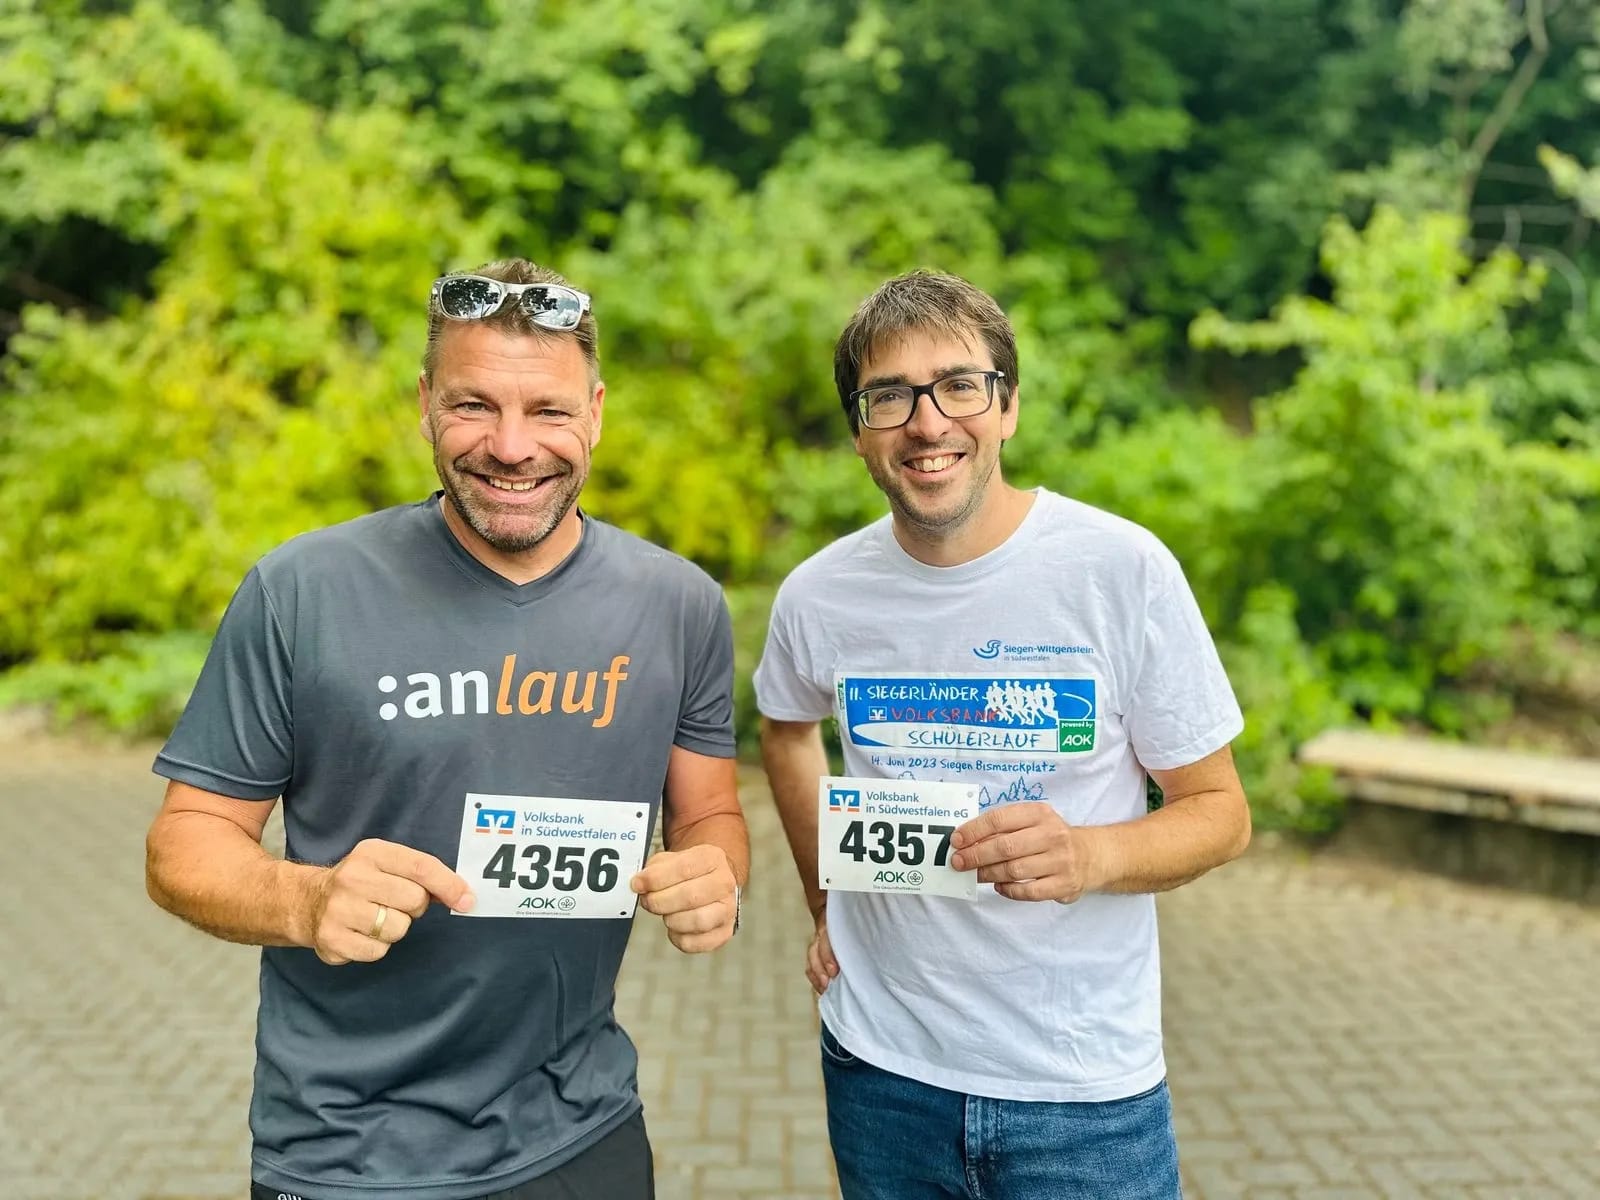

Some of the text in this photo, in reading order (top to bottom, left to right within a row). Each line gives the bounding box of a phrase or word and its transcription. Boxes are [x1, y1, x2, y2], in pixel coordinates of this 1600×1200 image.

[1003, 645, 1094, 655] Siegen-Wittgenstein
[867, 682, 979, 702] SIEGERLÄNDER
[891, 706, 1000, 723] VOLKSBANK
[908, 726, 1042, 749] SCHÜLERLAUF
[1062, 734, 1092, 746] AOK
[871, 755, 1056, 774] 14. Juni 2023 Siegen Bismarckplatz
[866, 791, 920, 803] Volksbank
[523, 811, 584, 825] Volksbank
[866, 803, 969, 818] in Südwestfalen eG
[521, 826, 637, 841] in Südwestfalen eG
[839, 820, 956, 867] 4357
[482, 843, 620, 893] 4356
[873, 870, 906, 883] AOK
[518, 897, 556, 909] AOK
